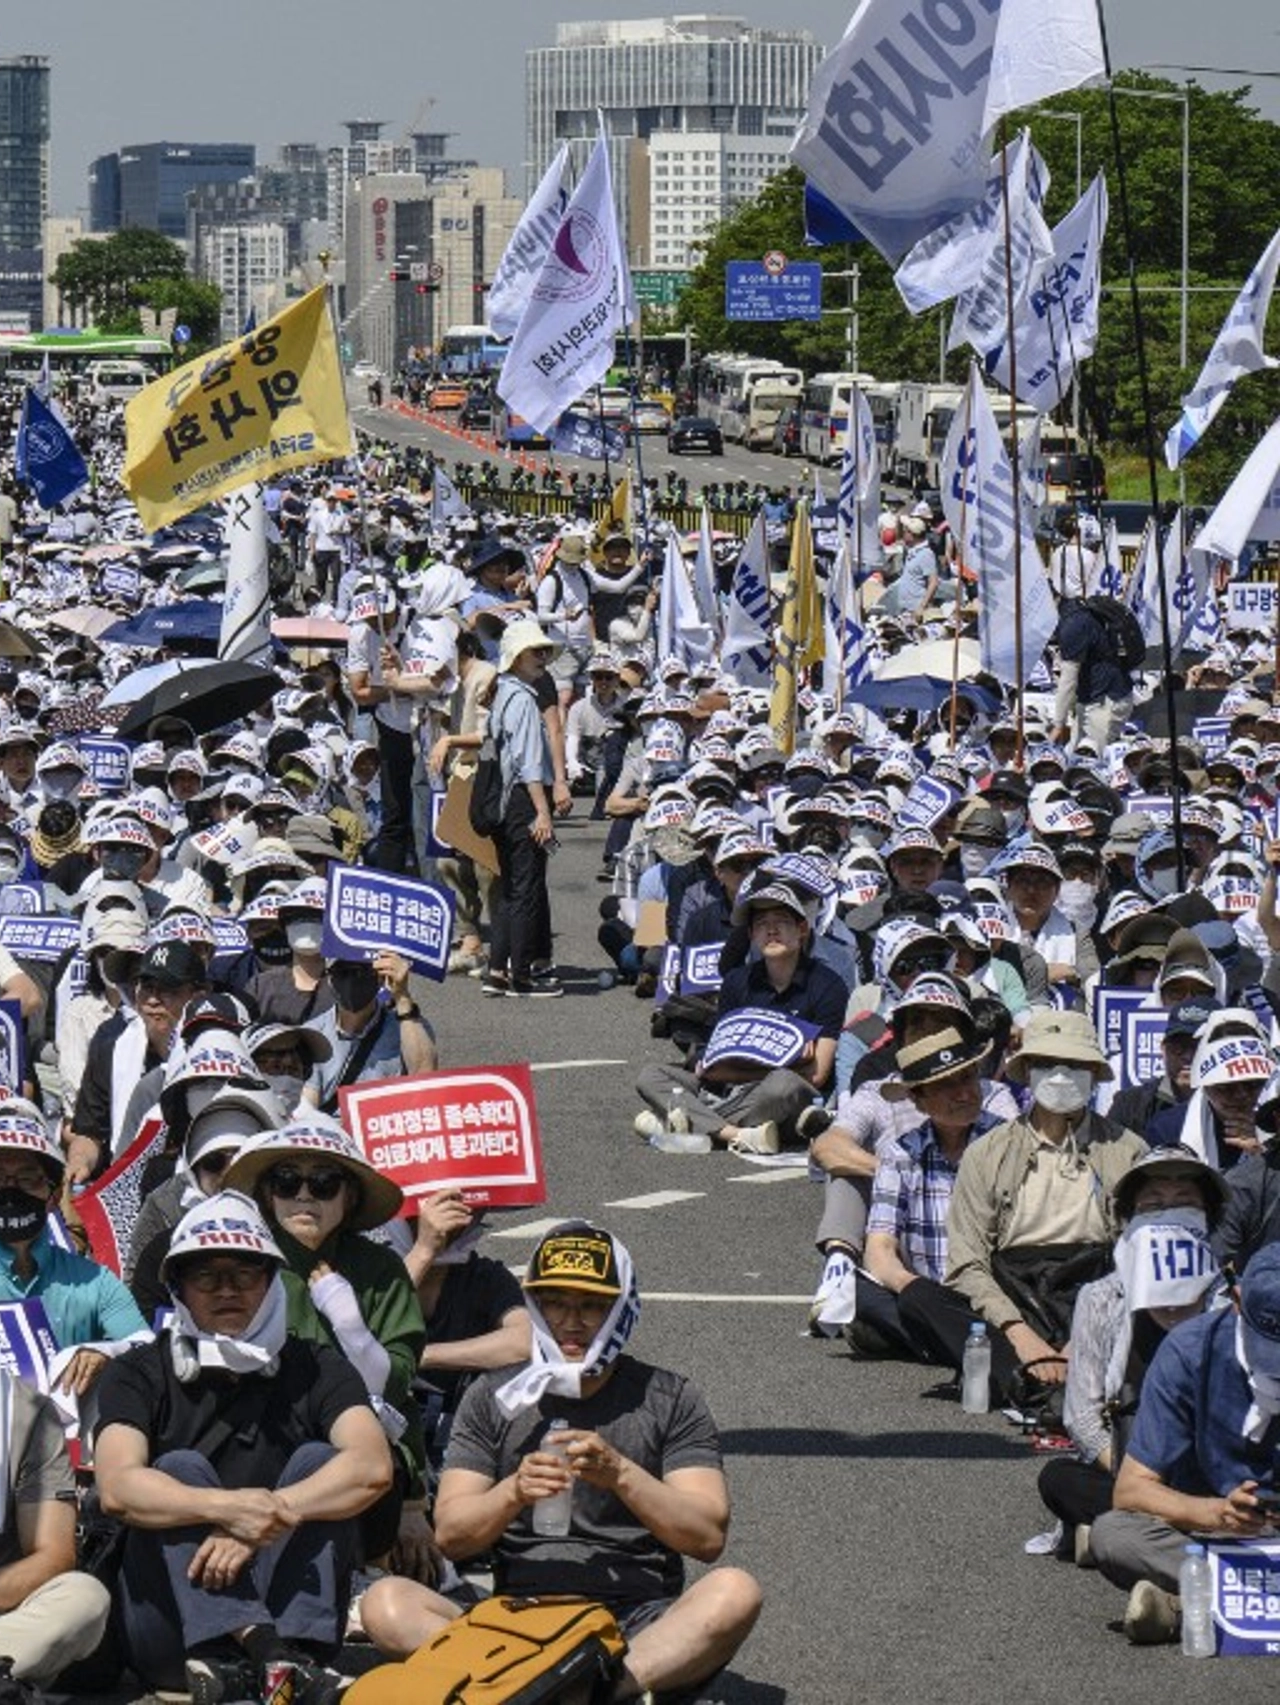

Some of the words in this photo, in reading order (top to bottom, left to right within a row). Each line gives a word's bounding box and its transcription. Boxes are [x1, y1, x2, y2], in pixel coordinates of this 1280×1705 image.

[366, 1105, 442, 1140] 의대정원
[444, 1100, 517, 1130] 졸속확대
[371, 1134, 447, 1170] 의료체계
[449, 1130, 519, 1160] 붕괴된다
